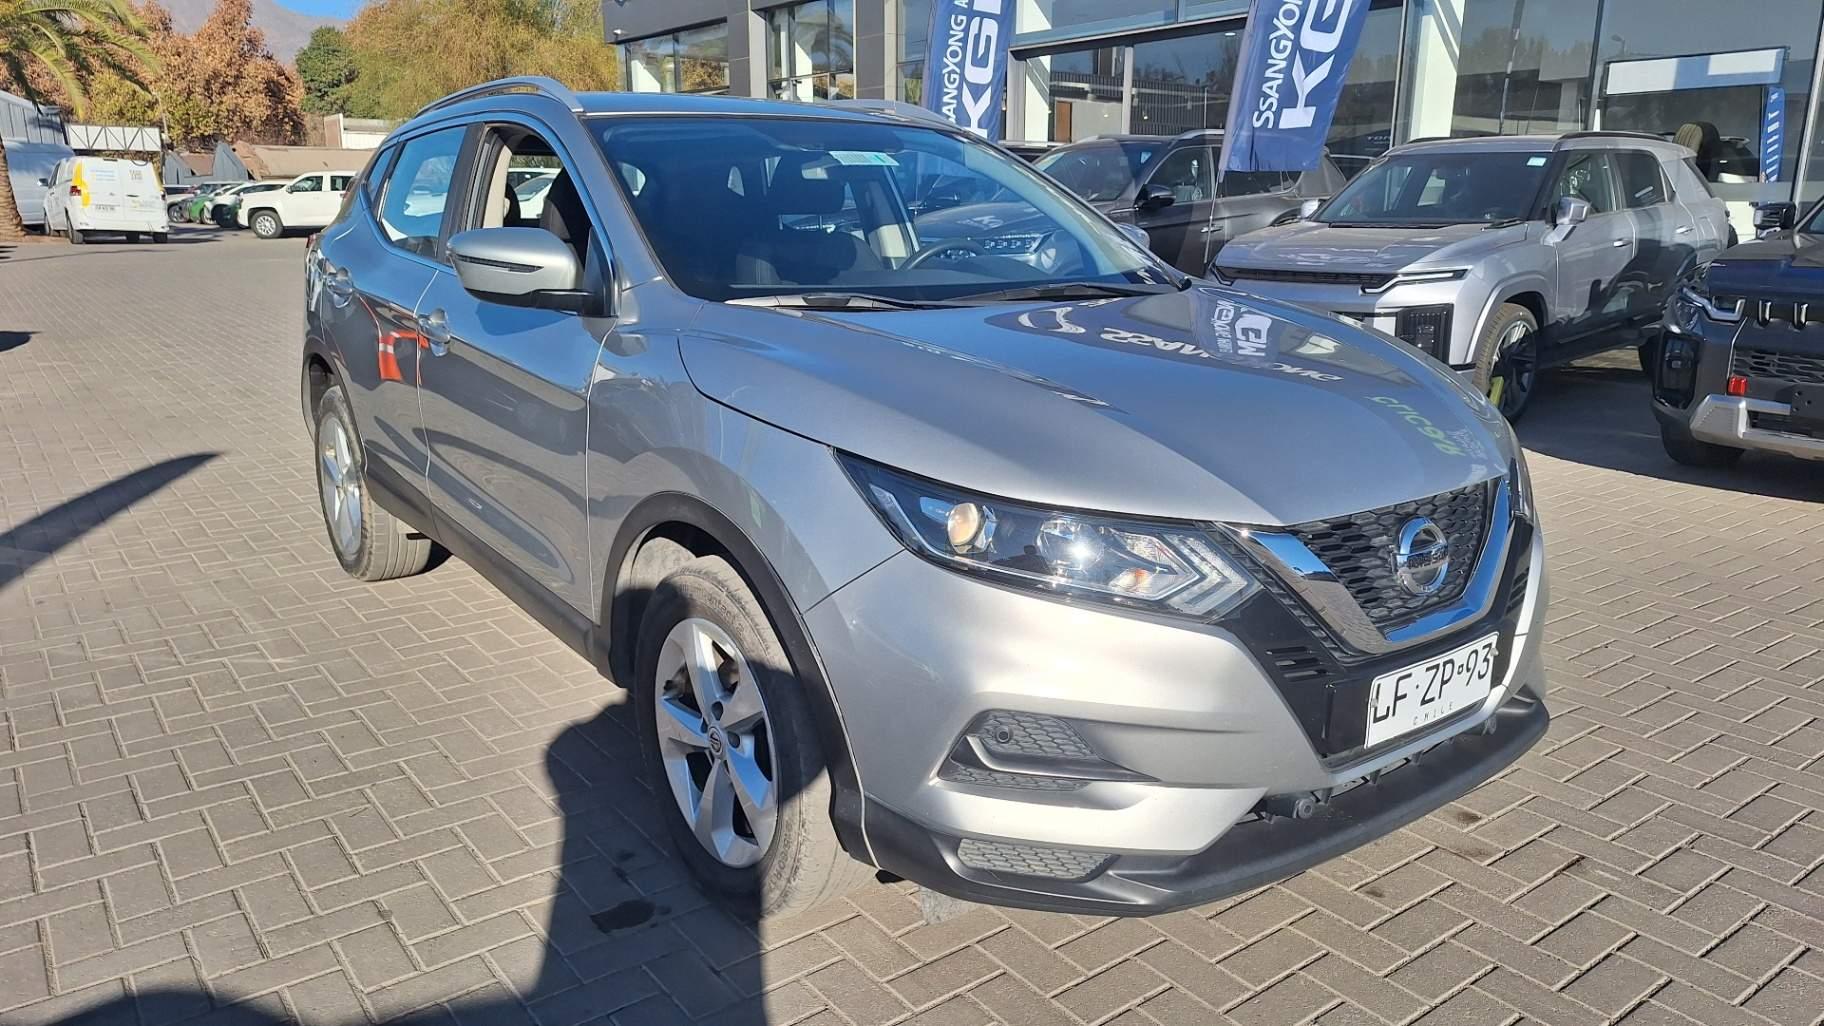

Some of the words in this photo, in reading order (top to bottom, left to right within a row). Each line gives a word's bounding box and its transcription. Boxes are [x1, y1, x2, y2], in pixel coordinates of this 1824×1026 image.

[942, 14, 967, 124] ANGYONG
[961, 0, 1002, 139] KG
[1253, 0, 1302, 129] SSANGYO
